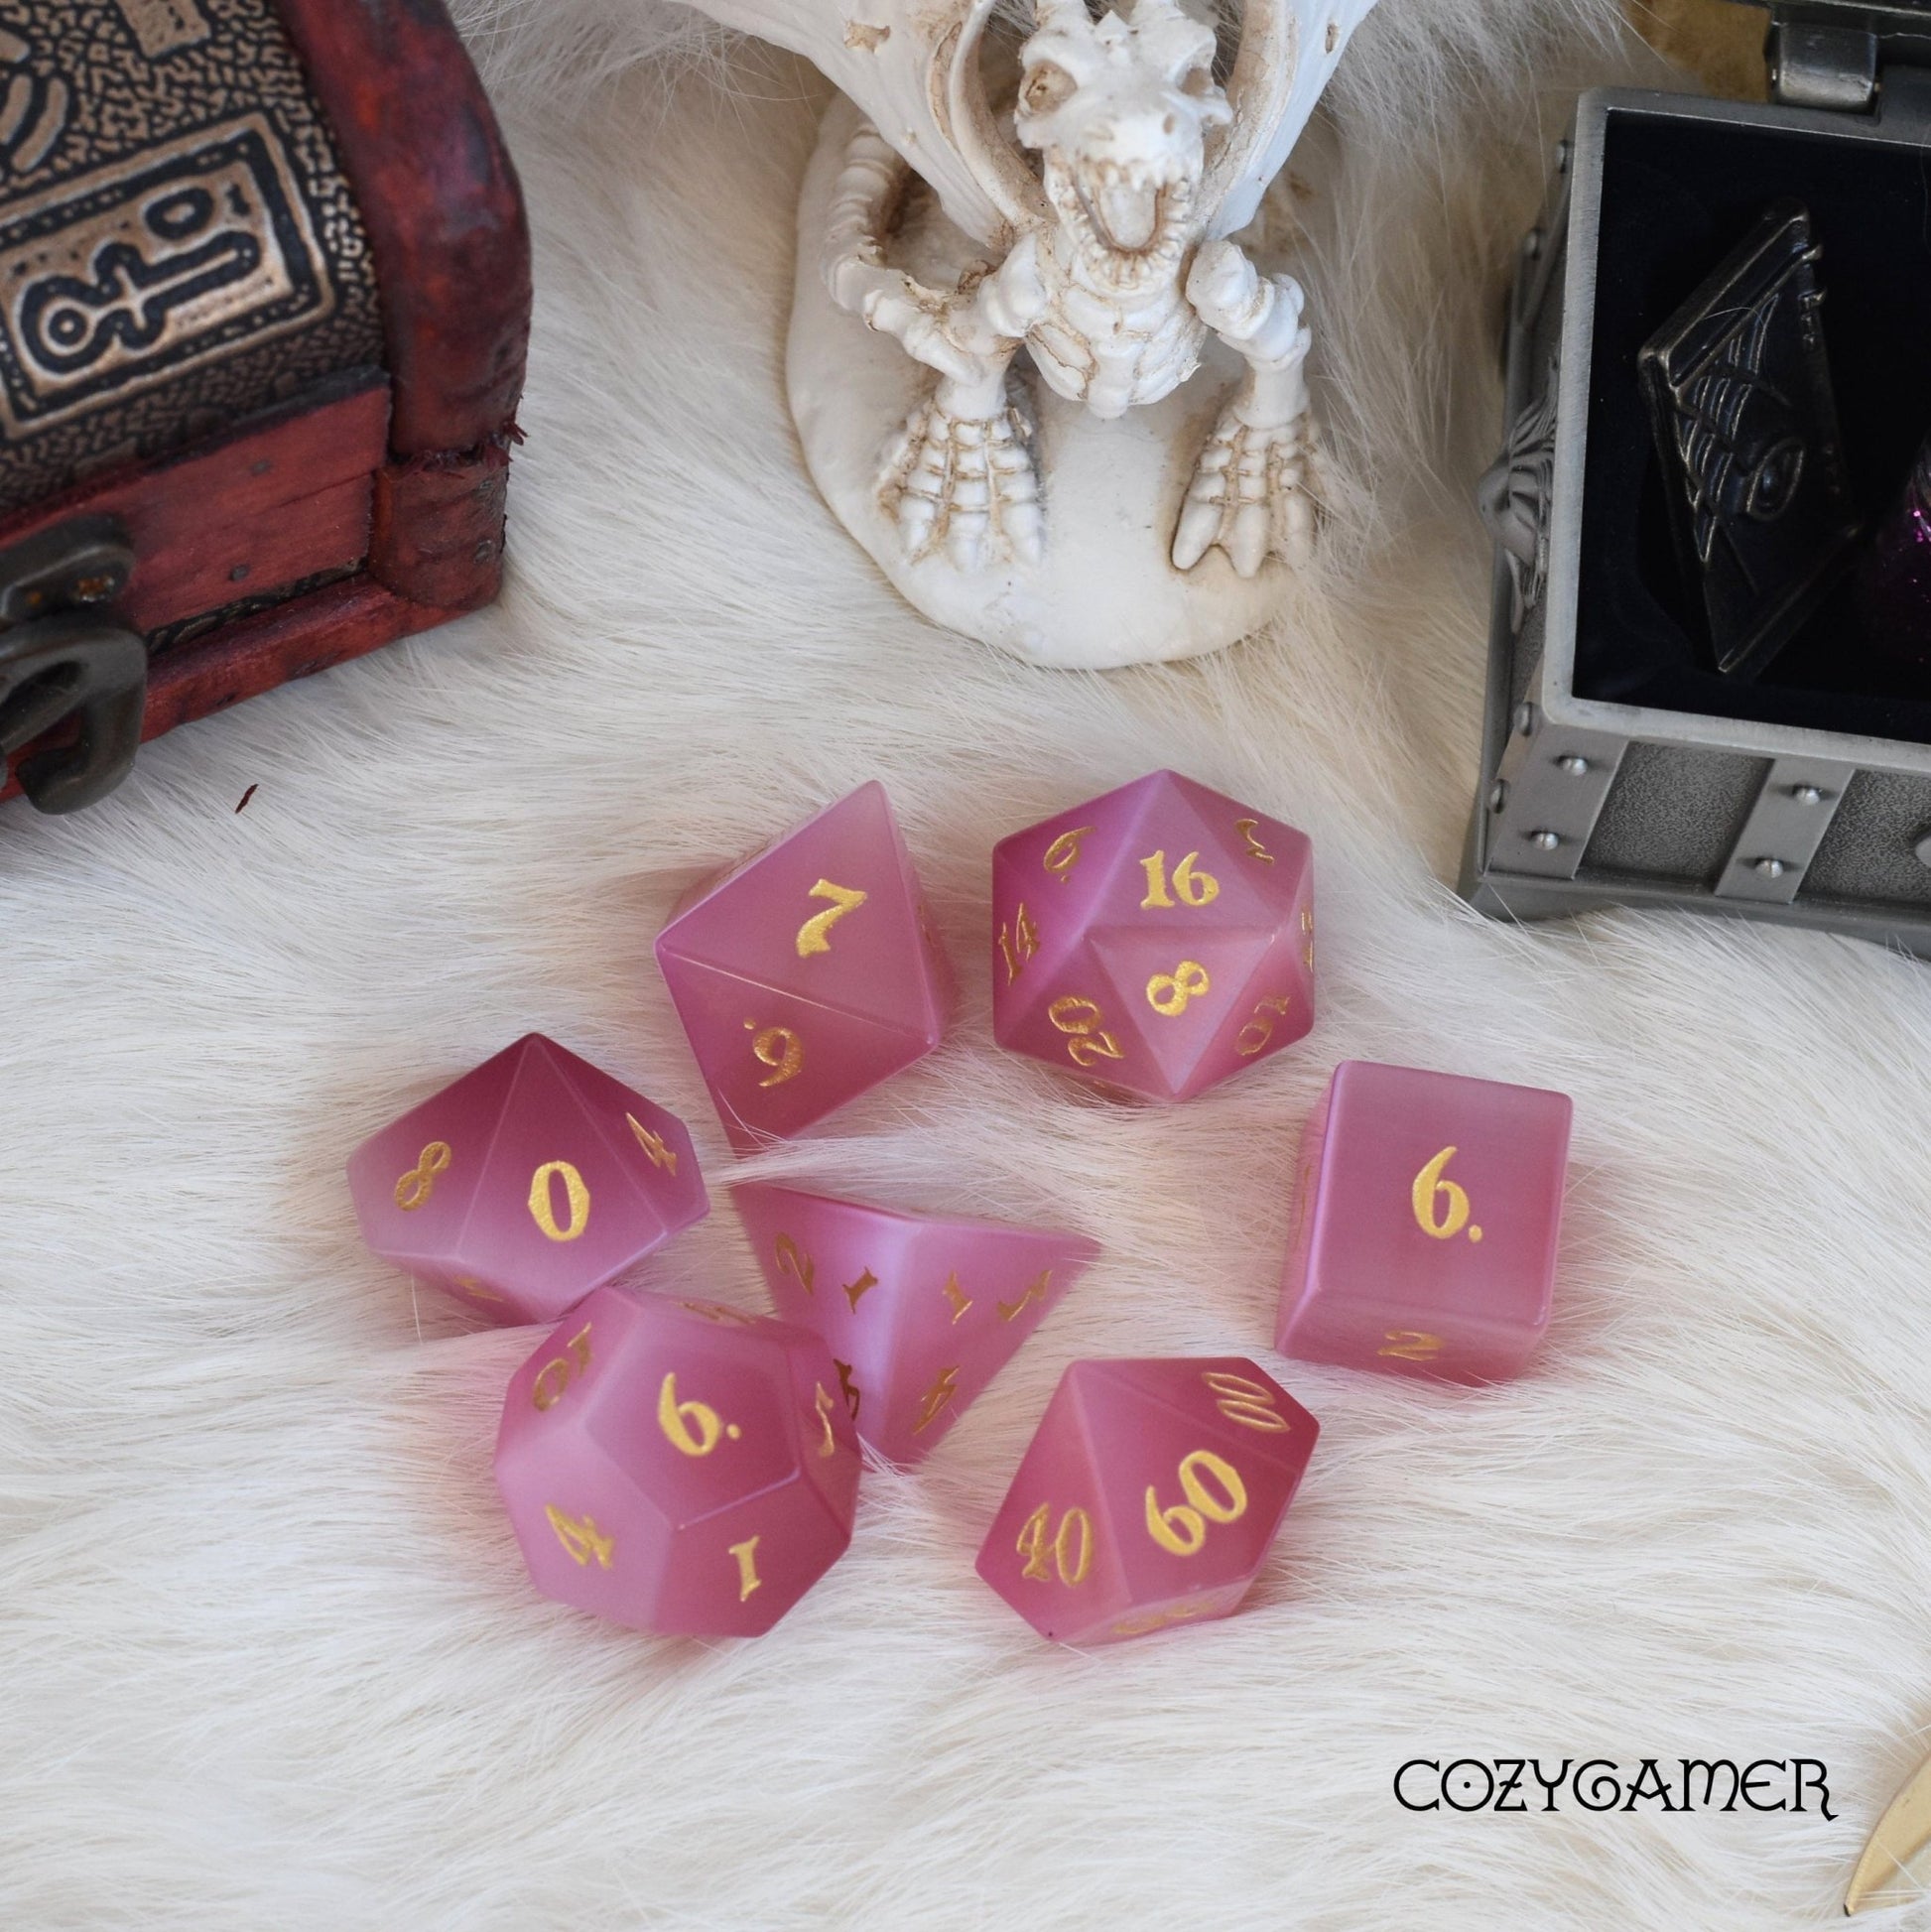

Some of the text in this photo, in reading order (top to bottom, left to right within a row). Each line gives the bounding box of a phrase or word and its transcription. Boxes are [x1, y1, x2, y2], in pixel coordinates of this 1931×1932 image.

[1139, 849, 1221, 909] 16
[796, 877, 868, 959] 7
[1145, 960, 1210, 1017] 8
[1048, 994, 1124, 1067] 20
[395, 1140, 452, 1212] 8
[625, 1111, 678, 1177] 4
[527, 1159, 590, 1242] 0
[774, 1231, 816, 1296] 2
[1376, 1330, 1446, 1361] 2
[1201, 1370, 1291, 1433] 00
[545, 1502, 614, 1570] 4
[1144, 1449, 1248, 1557] 60
[728, 1534, 763, 1604] 1
[1015, 1501, 1094, 1590] 40
